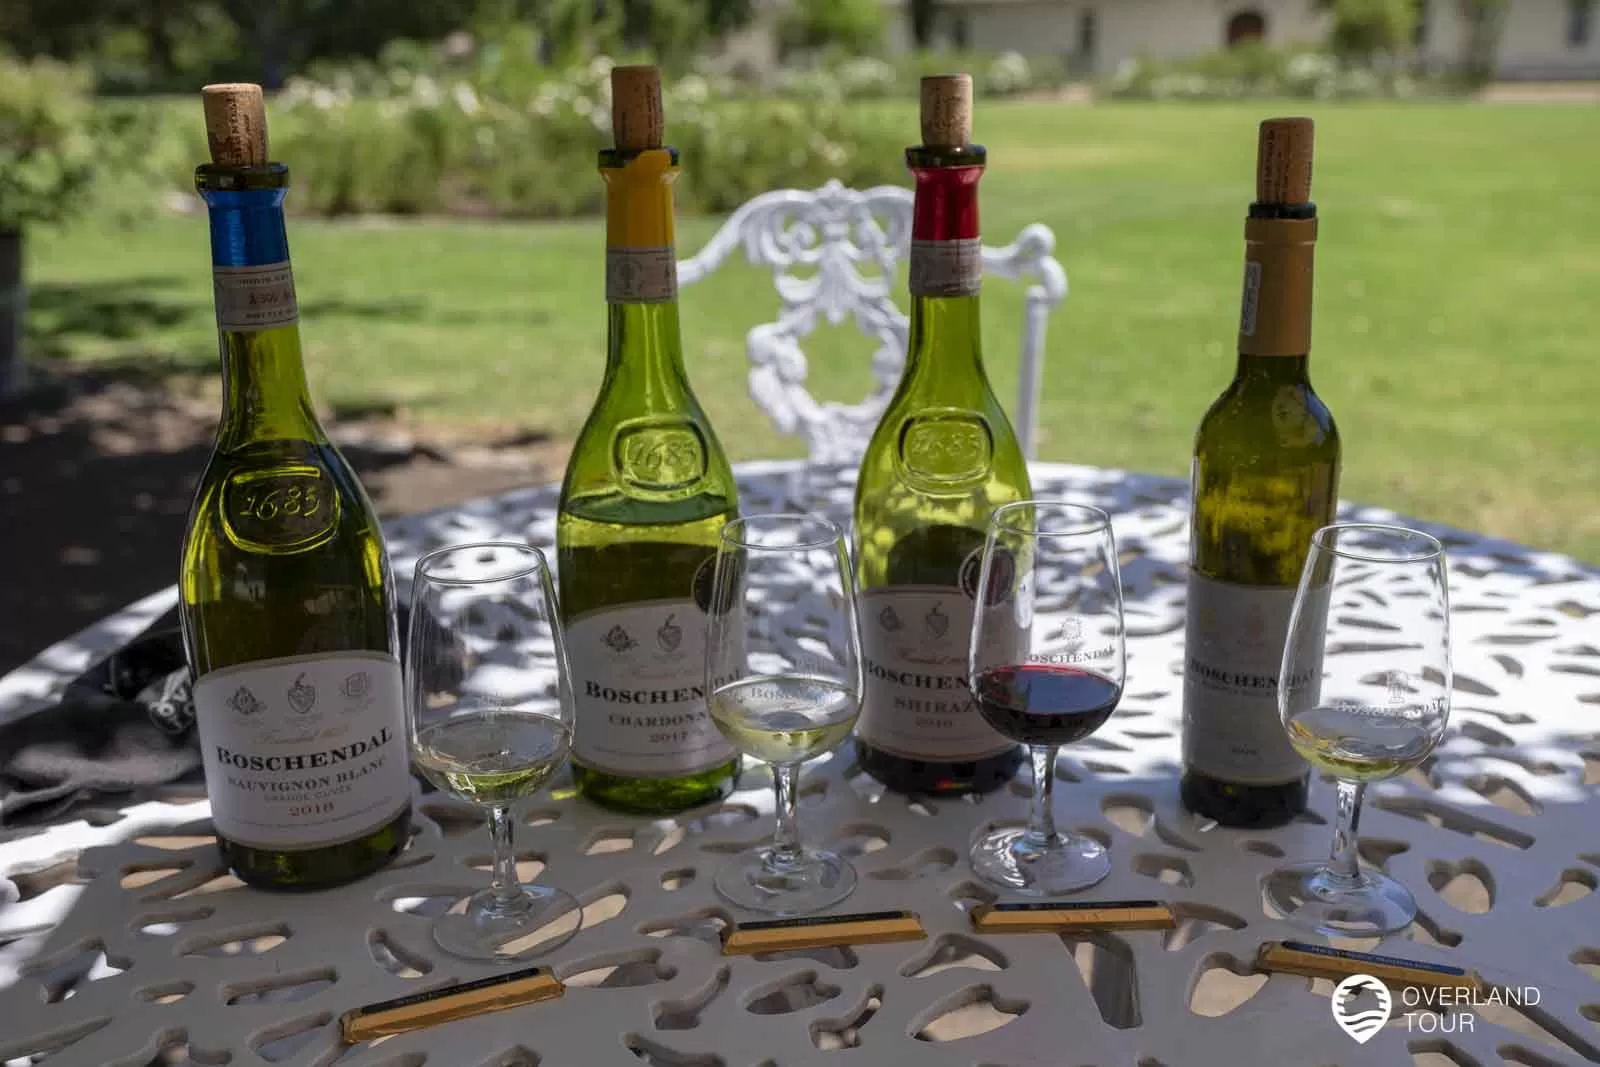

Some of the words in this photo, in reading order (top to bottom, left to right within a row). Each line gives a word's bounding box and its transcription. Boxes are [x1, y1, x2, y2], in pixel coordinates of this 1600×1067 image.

[239, 486, 321, 521] 1685
[864, 659, 969, 689] BOSCHEN
[608, 711, 706, 729] CHARDONN
[894, 696, 974, 713] SHIRAZ
[216, 726, 393, 772] BOSCHENDAL
[228, 775, 330, 793] SAUVIGNON
[336, 754, 387, 784] BLANC
